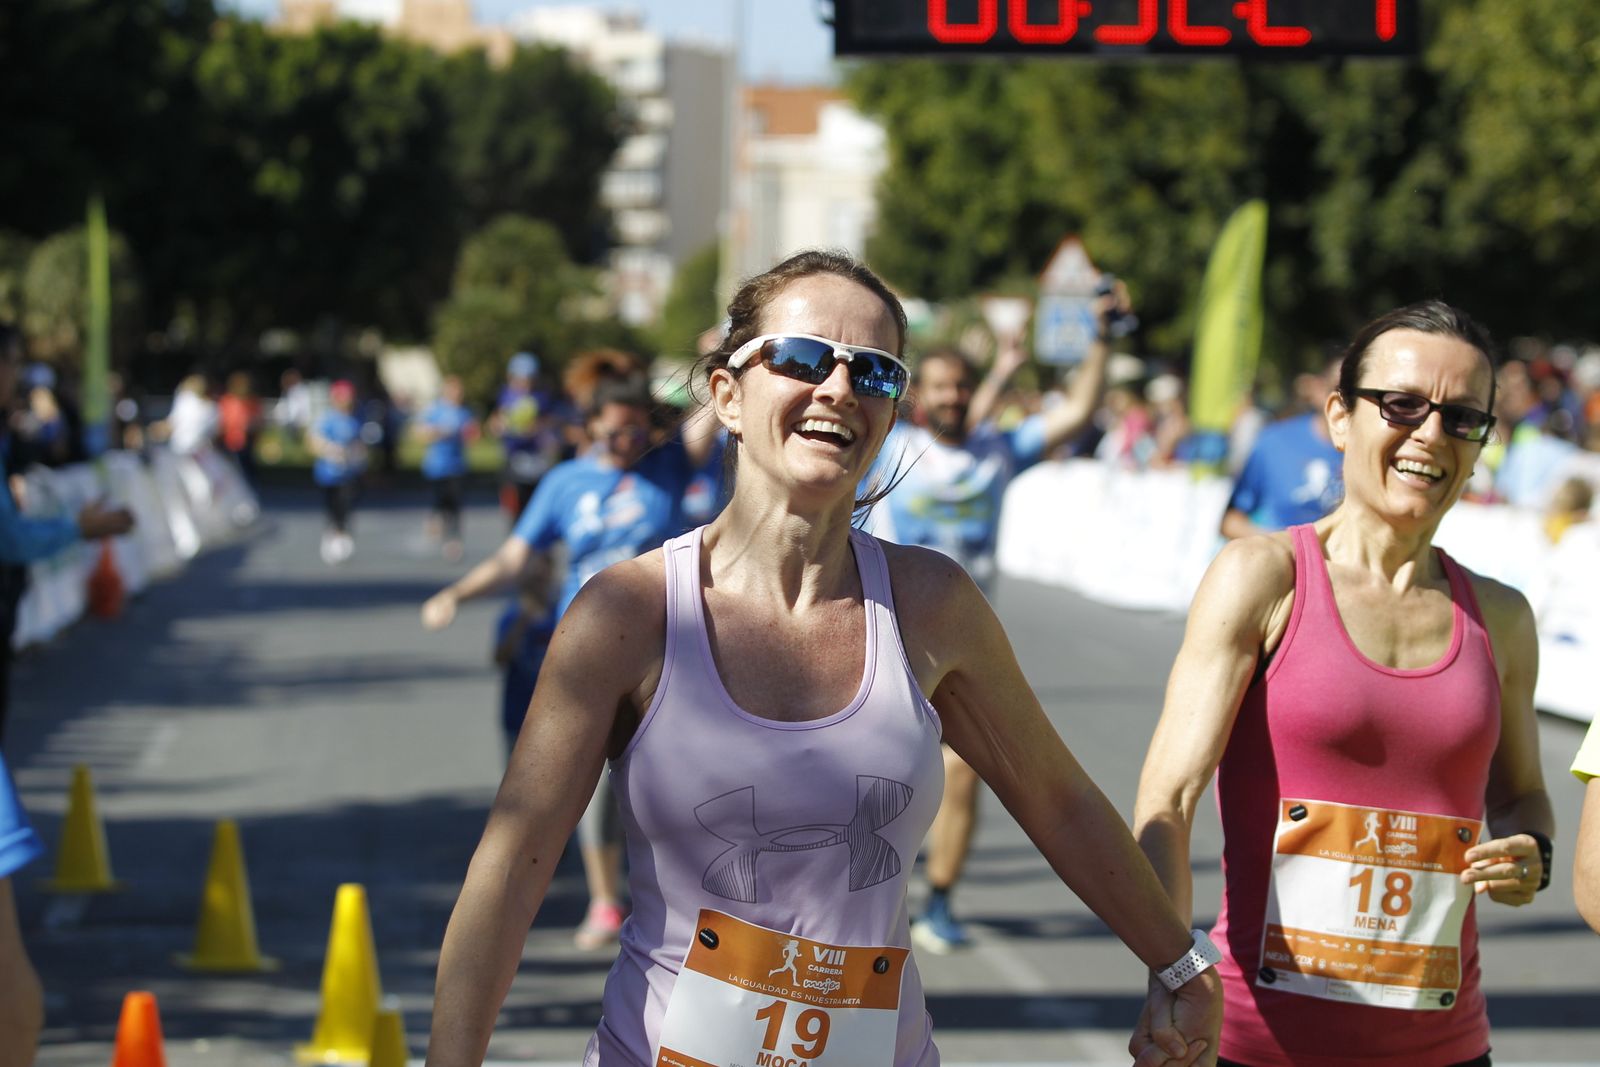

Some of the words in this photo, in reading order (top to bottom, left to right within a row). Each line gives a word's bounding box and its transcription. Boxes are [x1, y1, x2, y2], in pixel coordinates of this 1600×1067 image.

[1388, 814, 1417, 831] VIII
[1349, 867, 1413, 917] 18
[1354, 915, 1398, 931] MENA
[813, 945, 847, 966] VIII
[807, 964, 843, 976] CARRERA
[728, 973, 738, 983] LA
[740, 976, 789, 995] IGUALDAD
[790, 991, 802, 999] ES
[804, 994, 842, 1004] NUESTRA
[755, 999, 831, 1060] 19
